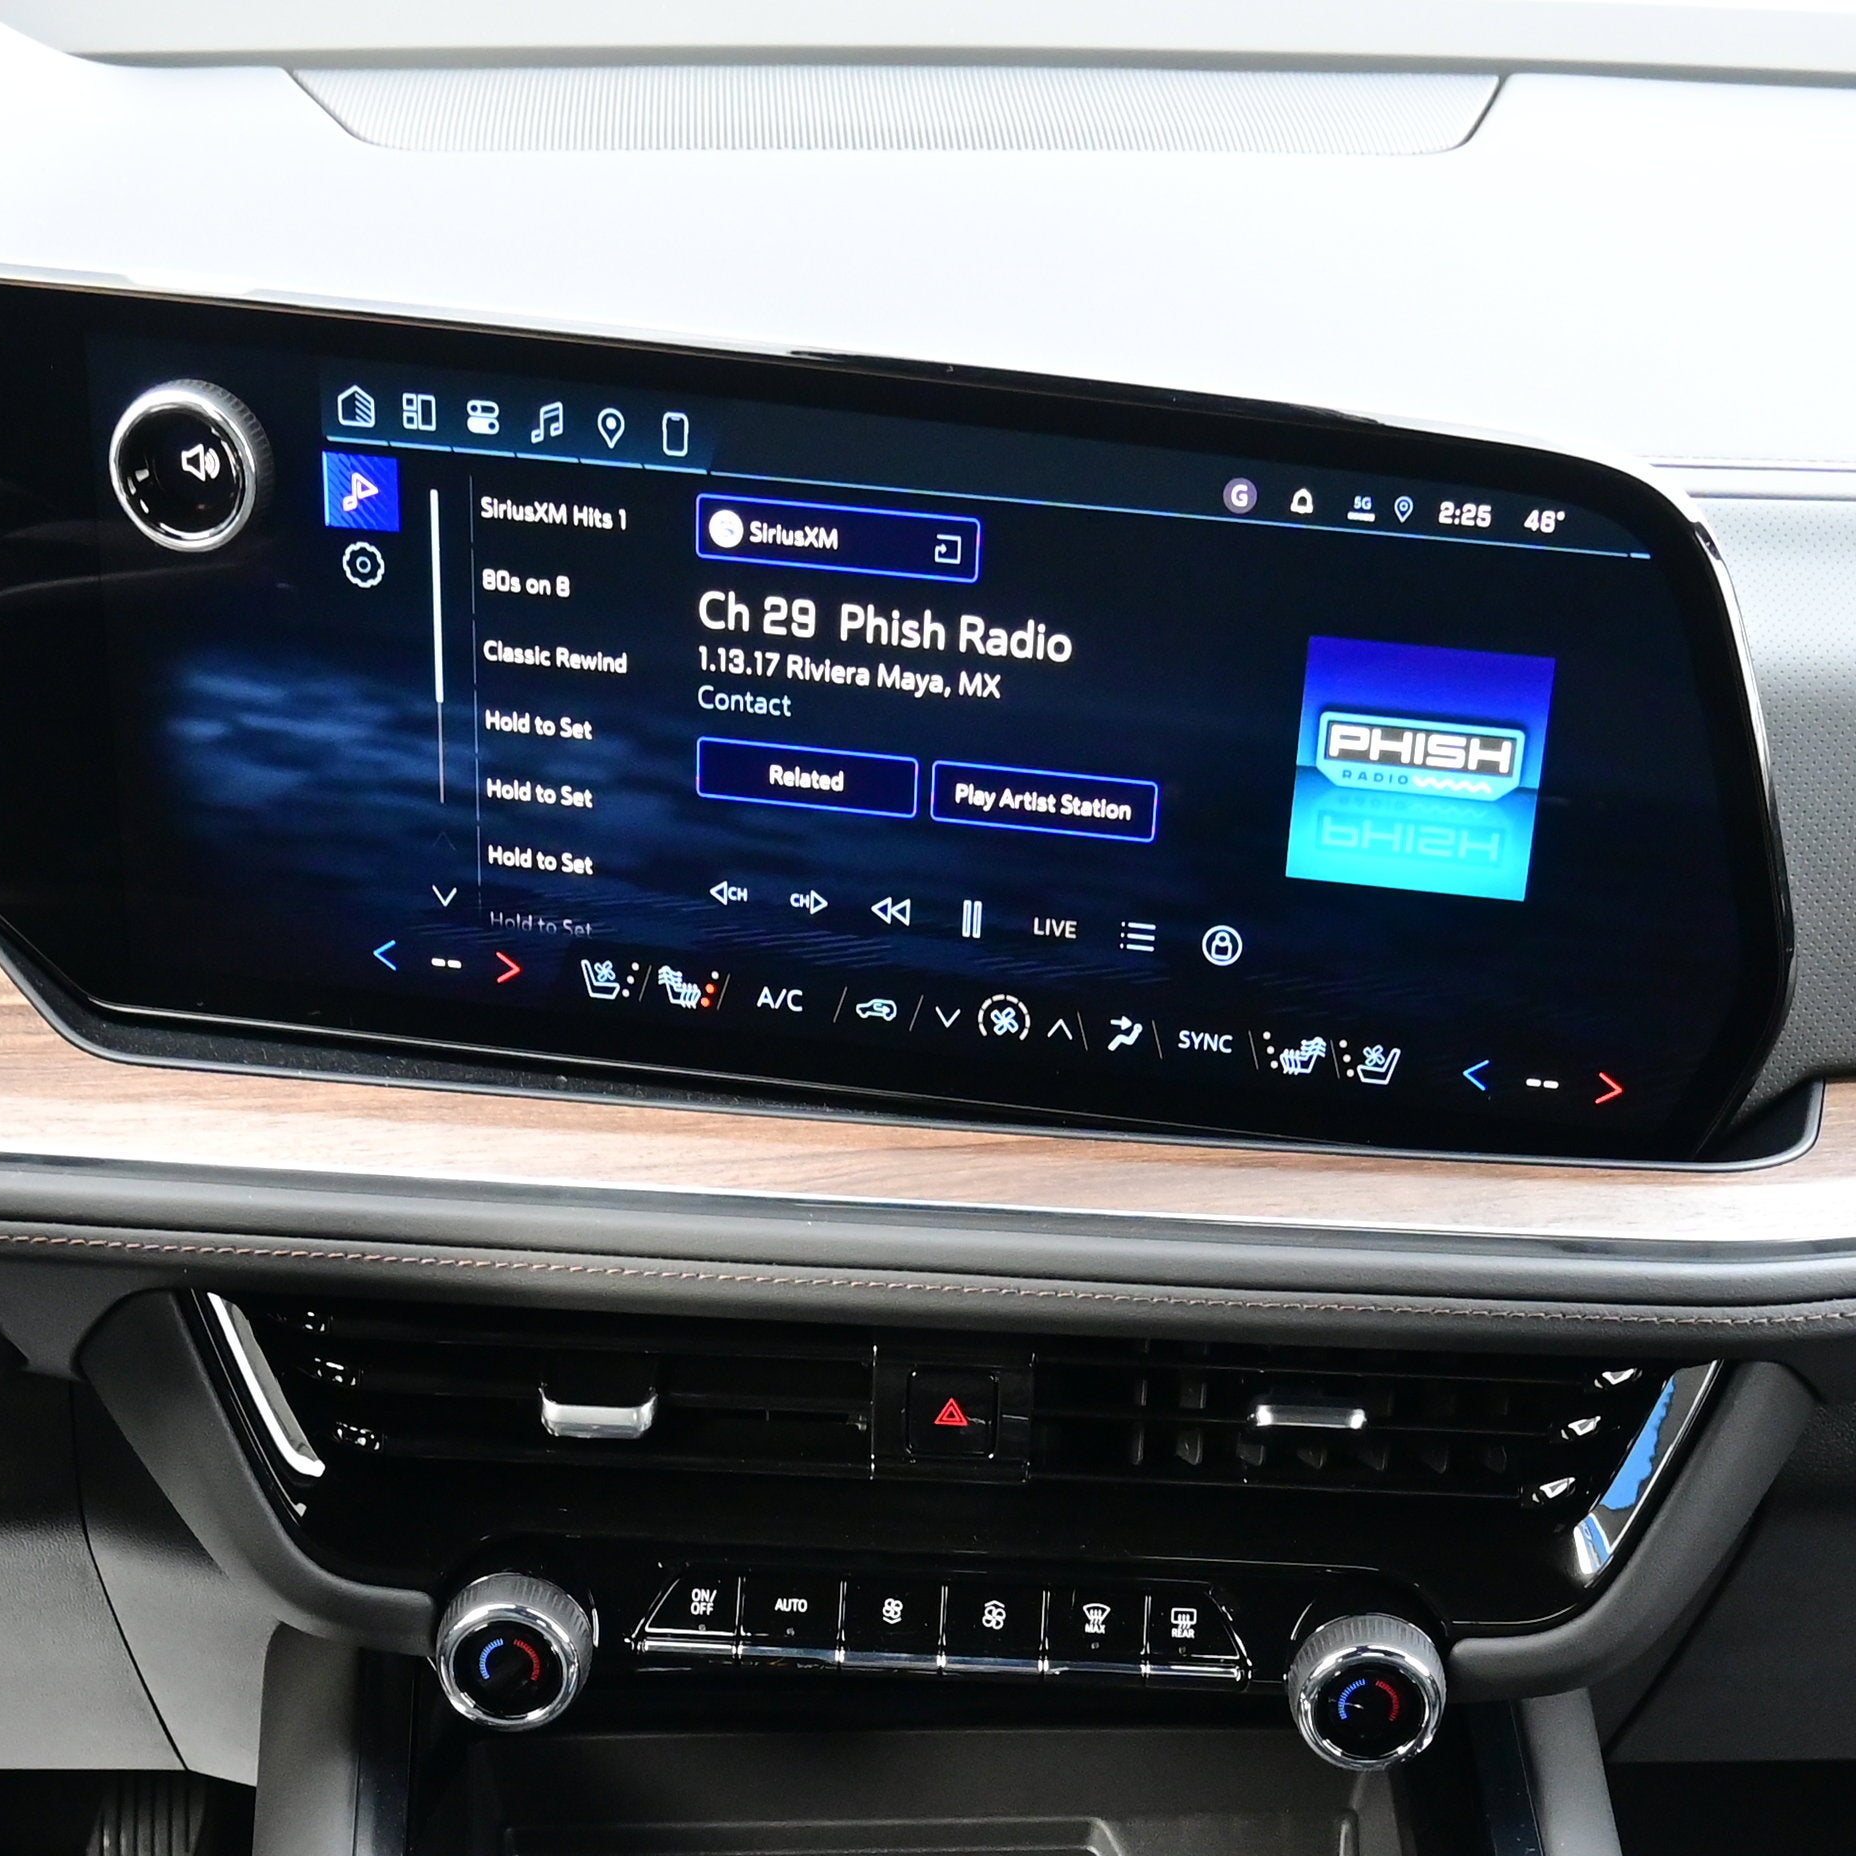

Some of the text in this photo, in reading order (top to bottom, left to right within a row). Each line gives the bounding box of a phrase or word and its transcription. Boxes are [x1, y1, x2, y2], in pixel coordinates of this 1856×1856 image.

[1230, 485, 1249, 507] G
[480, 496, 627, 531] SiriusXM Hits 1
[1438, 501, 1492, 528] 2:25
[749, 520, 839, 551] SiriusXM
[482, 568, 570, 597] 80s on 8
[698, 590, 1073, 663] Ch 29 Phish Radio
[483, 639, 627, 674] Classic Rewind
[698, 645, 1002, 700] 1.13.17 Riviera Maya, MX
[697, 684, 792, 718] Contact
[485, 709, 593, 740] Hold to Set
[1328, 722, 1513, 774] PHISH
[768, 763, 845, 793] Related
[1341, 768, 1409, 787] RADIO
[487, 778, 593, 808] Hold to Set
[955, 782, 1133, 821] Play Artist Station
[488, 845, 593, 876] Hold to Set
[728, 886, 748, 903] CH
[789, 893, 811, 909] CH
[490, 911, 593, 938] Hold to Set
[1033, 916, 1077, 939] LIVE
[756, 985, 803, 1012] A/C
[1177, 1029, 1234, 1054] SYNC
[690, 1602, 714, 1616] OFF
[691, 1588, 718, 1603] ON/
[774, 1598, 808, 1613] AUTO
[1085, 1623, 1106, 1634] MAX
[1171, 1628, 1195, 1639] REAR
